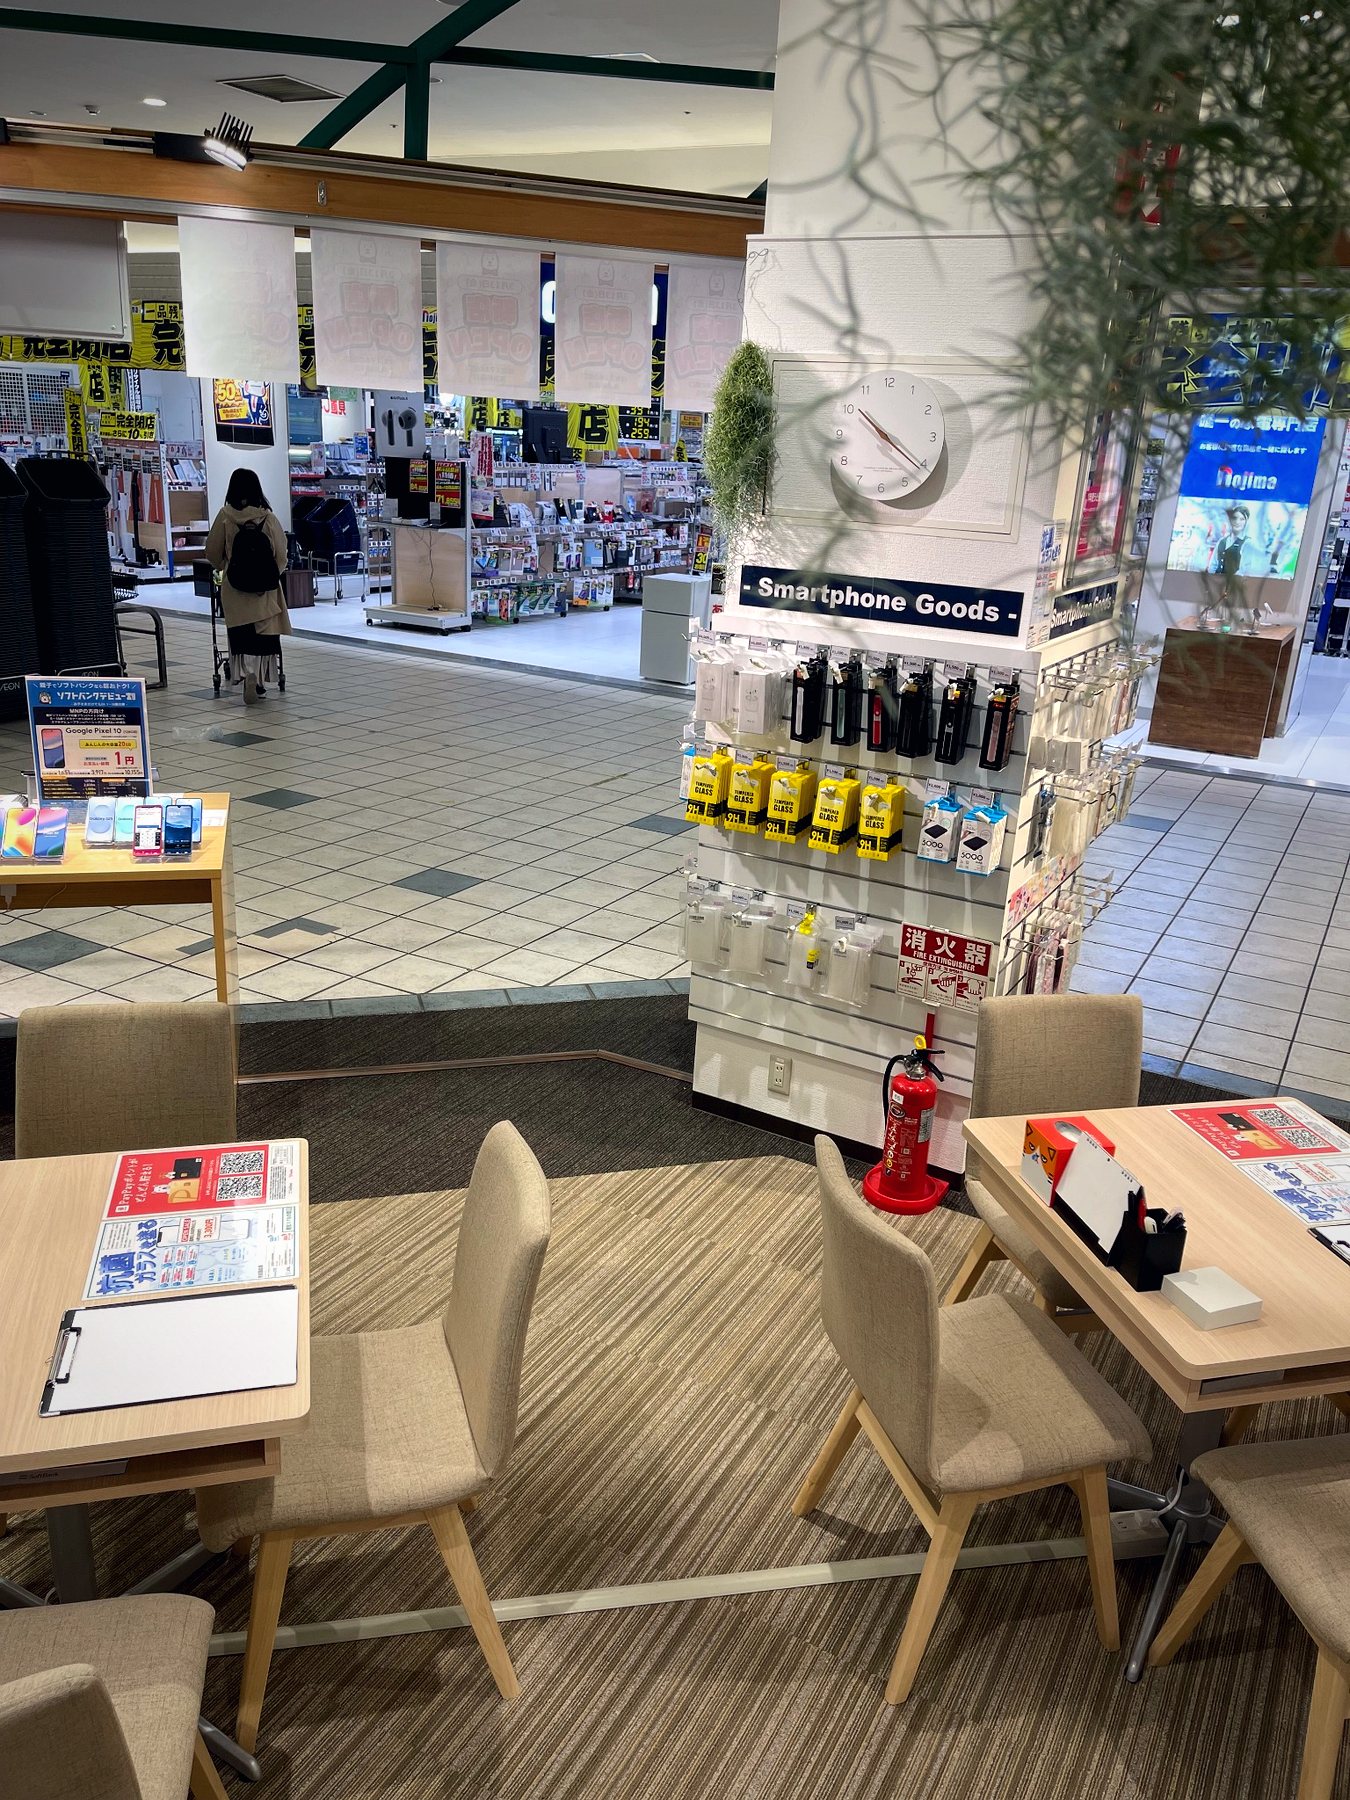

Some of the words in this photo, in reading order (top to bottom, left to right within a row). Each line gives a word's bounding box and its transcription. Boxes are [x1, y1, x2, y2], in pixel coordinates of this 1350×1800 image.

[884, 377, 895, 388] 12
[861, 385, 870, 395] 11
[911, 385, 915, 395] 1
[843, 403, 854, 414] 10
[924, 404, 932, 415] 2
[117, 414, 155, 429] 完全閉店
[634, 417, 650, 428] 194
[631, 427, 649, 439] 259
[836, 429, 843, 439] 9
[929, 432, 937, 442] 3
[840, 455, 848, 466] 8
[920, 458, 927, 468] 4
[856, 475, 863, 485] 7
[901, 476, 909, 487] 5
[877, 482, 885, 493] 6
[758, 577, 906, 612] Smartphone
[915, 594, 1000, 623] Goods
[694, 786, 713, 797] GLASS
[734, 795, 754, 804] GLASS
[687, 803, 700, 814] 9H
[773, 804, 794, 814] GLASS
[727, 812, 740, 823] 9H
[819, 812, 838, 823] GLASS
[766, 822, 779, 832] 9H
[865, 820, 884, 830] GLASS
[811, 831, 824, 841] 9H
[859, 839, 872, 850] 9H
[921, 839, 943, 849] 5000
[960, 852, 983, 861] 5000
[905, 927, 986, 967] 消火器
[913, 951, 927, 960] FIRE
[928, 954, 975, 972] EXTINGUISHER
[135, 1219, 158, 1283] ガラスを塗る
[96, 1251, 135, 1294] 抗菌
